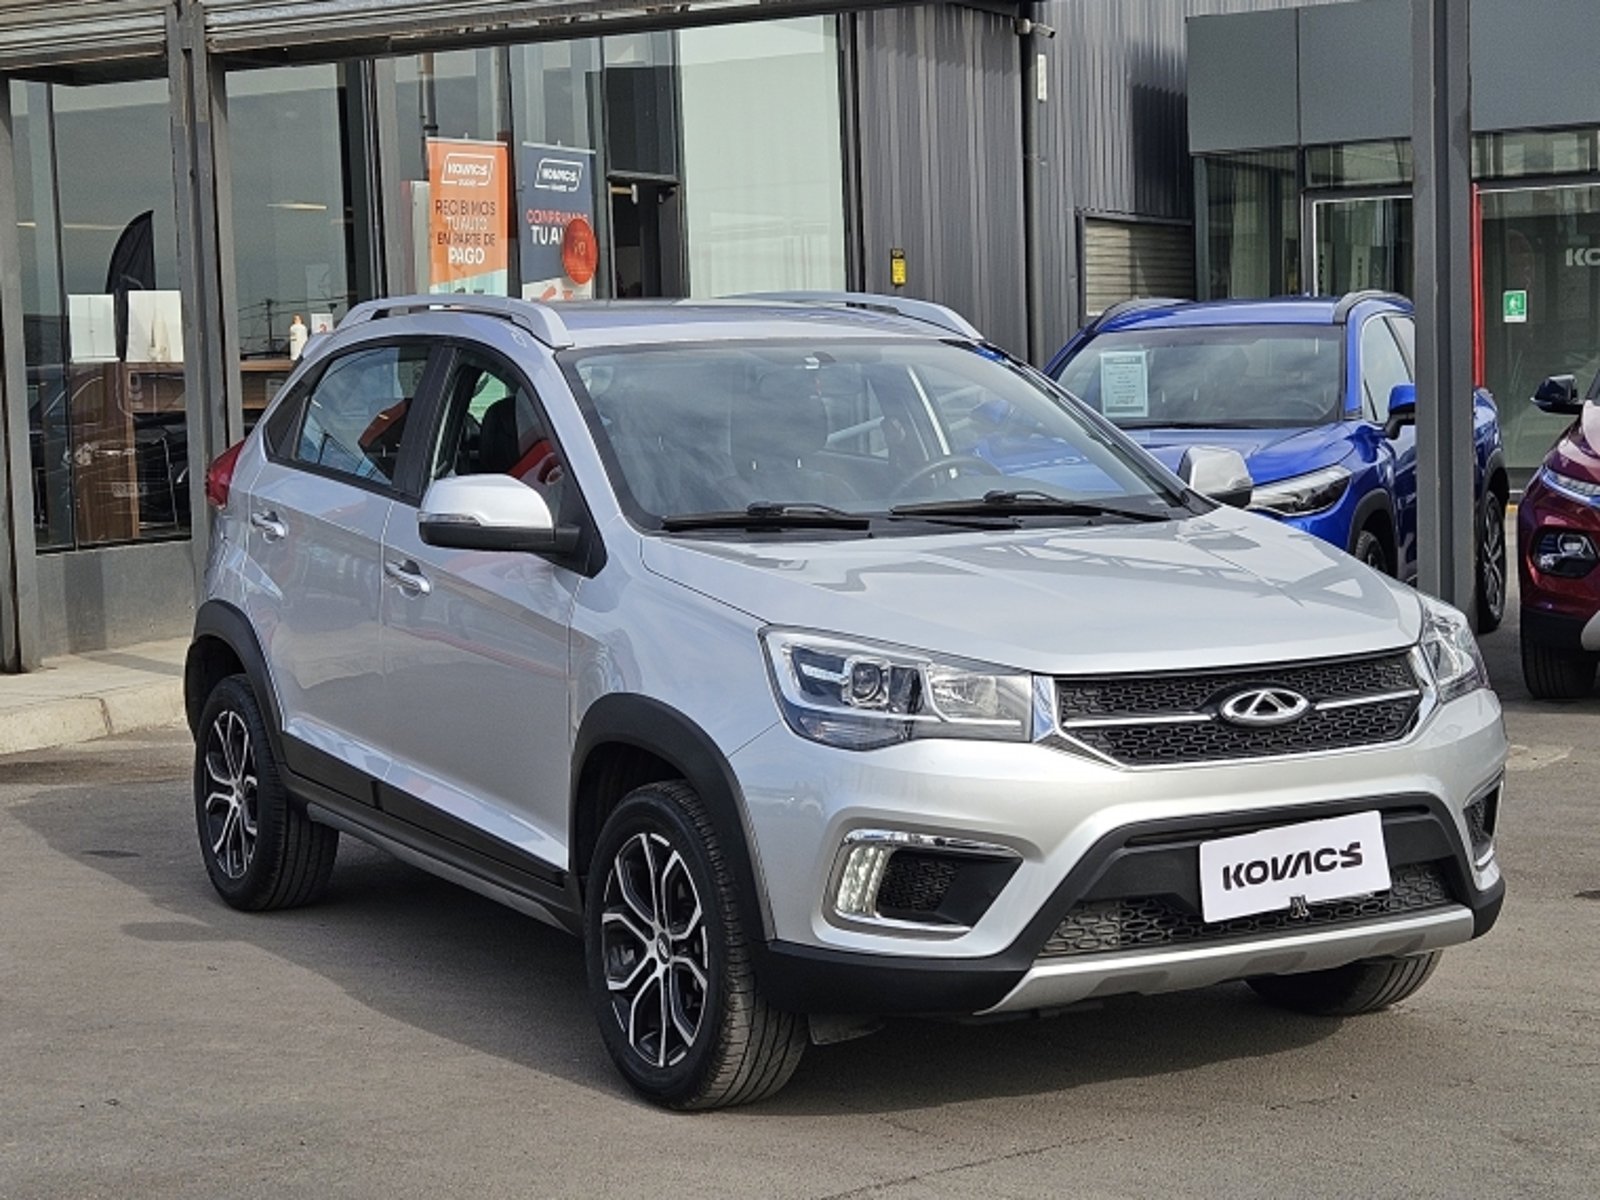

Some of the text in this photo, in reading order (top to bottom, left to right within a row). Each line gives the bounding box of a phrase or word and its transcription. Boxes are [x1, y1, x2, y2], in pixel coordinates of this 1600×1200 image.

[435, 199, 496, 216] RECIBIMOS
[446, 216, 459, 231] TU
[437, 231, 496, 247] EN PARTE DE
[530, 225, 548, 245] TU
[447, 246, 485, 265] PAGO
[1222, 841, 1363, 891] KOVACS
